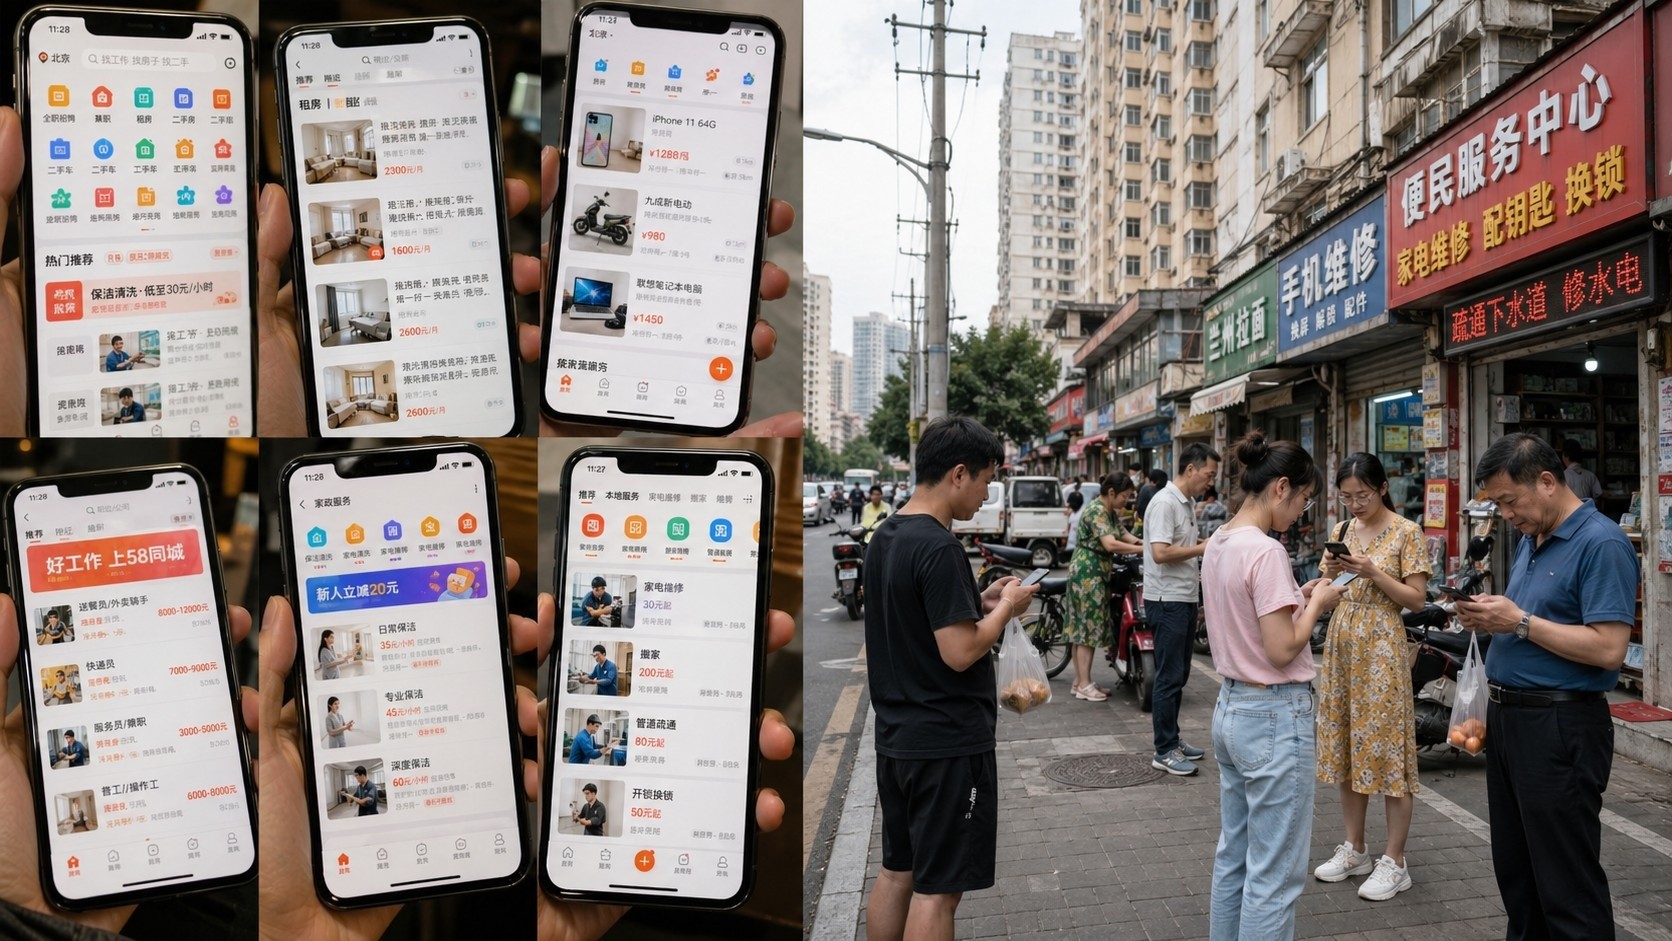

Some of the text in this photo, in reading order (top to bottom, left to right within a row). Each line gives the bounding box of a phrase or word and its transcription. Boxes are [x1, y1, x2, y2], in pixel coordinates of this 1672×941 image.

[49, 25, 70, 34] 11:28
[301, 42, 321, 50] 11:28
[652, 115, 716, 129] iPhone 11 64G
[1400, 63, 1614, 228] 便民服务中心
[1396, 144, 1626, 286] 家电维修 配钥匙 换锁
[642, 231, 665, 241] ¥980
[392, 245, 431, 255] 1600元/月
[1281, 222, 1378, 317] 手机维修
[1452, 252, 1642, 343] 疏通下水道 修水电
[633, 314, 664, 325] ¥1450
[399, 326, 438, 337] 2600元/月
[1208, 296, 1265, 361] 兰州拉面
[406, 407, 446, 417] 2600元/月
[587, 465, 606, 473] 11:27
[304, 473, 324, 481] 11:28
[30, 493, 48, 501] 11:28
[46, 544, 185, 575] 好工作 上58同城
[158, 603, 209, 617] 8000-12000元
[169, 661, 217, 675] 7000-9000元
[187, 785, 237, 800] 6000-8000元
